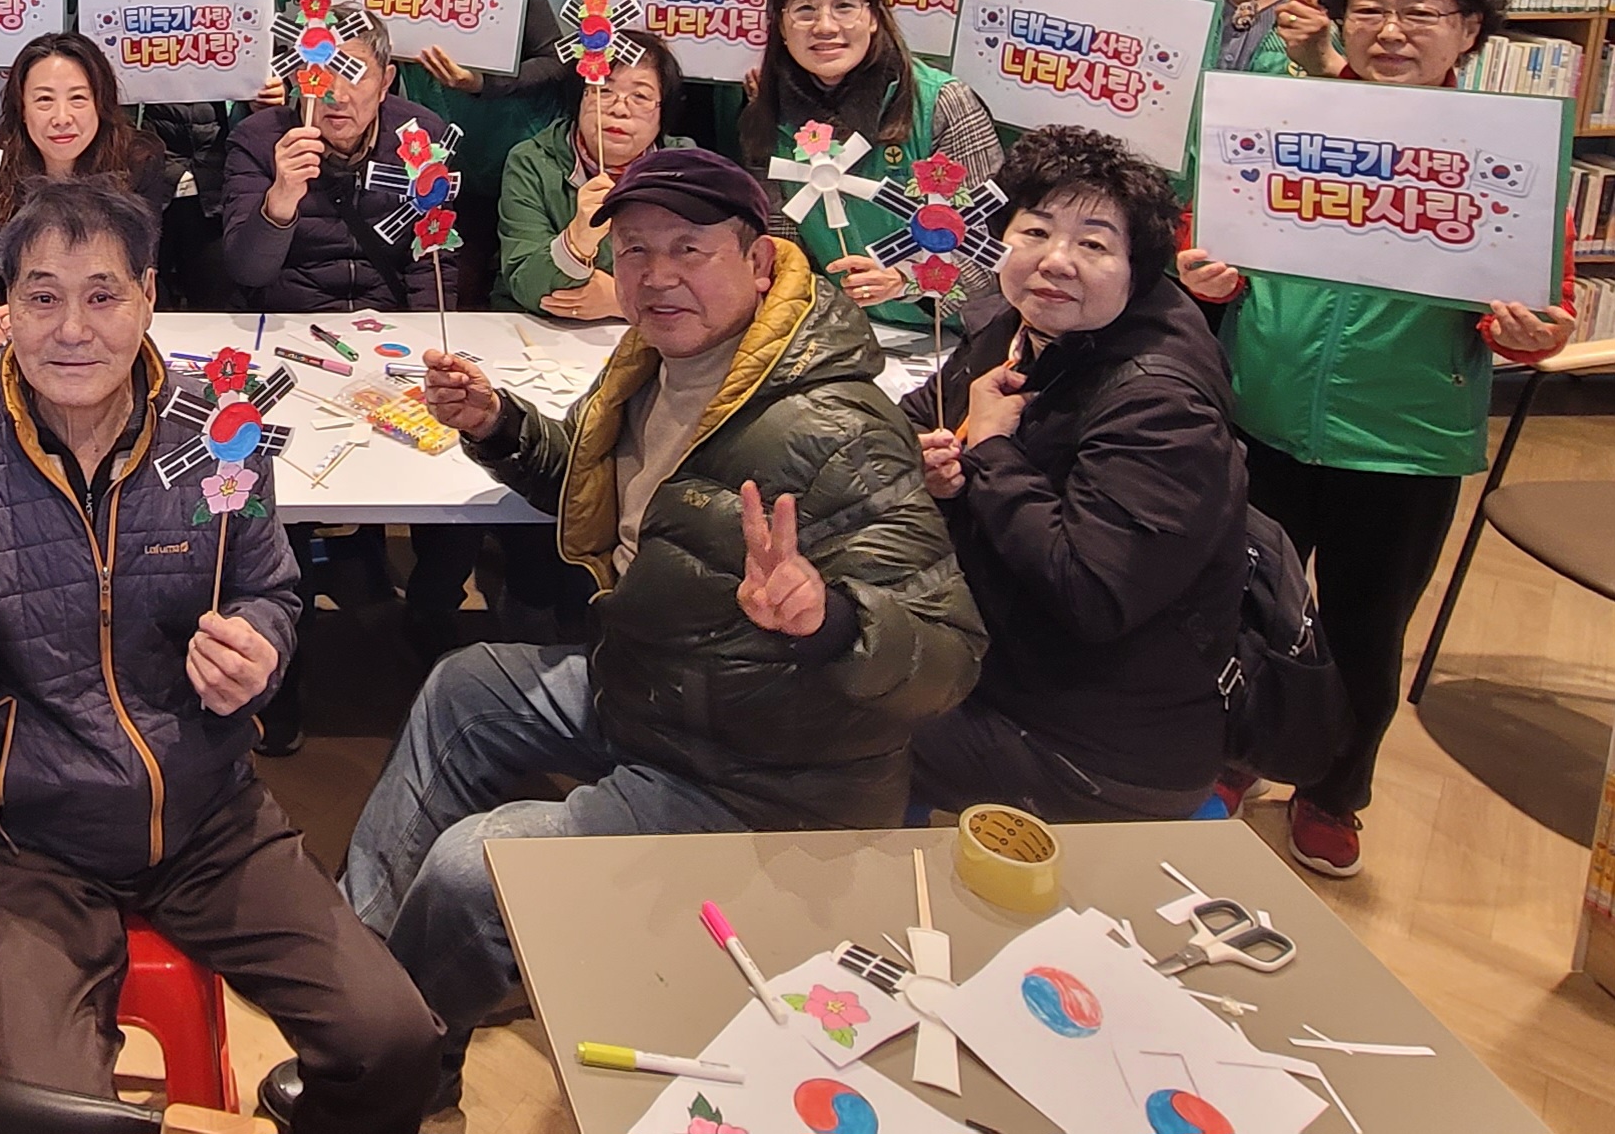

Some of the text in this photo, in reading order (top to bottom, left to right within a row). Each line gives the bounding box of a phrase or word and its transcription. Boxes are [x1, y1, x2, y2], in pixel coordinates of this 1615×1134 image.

[121, 32, 239, 66] 나라사랑
[646, 3, 768, 46] 나라사랑
[1001, 42, 1146, 111] 나라사랑
[1267, 173, 1483, 245] 나라사랑
